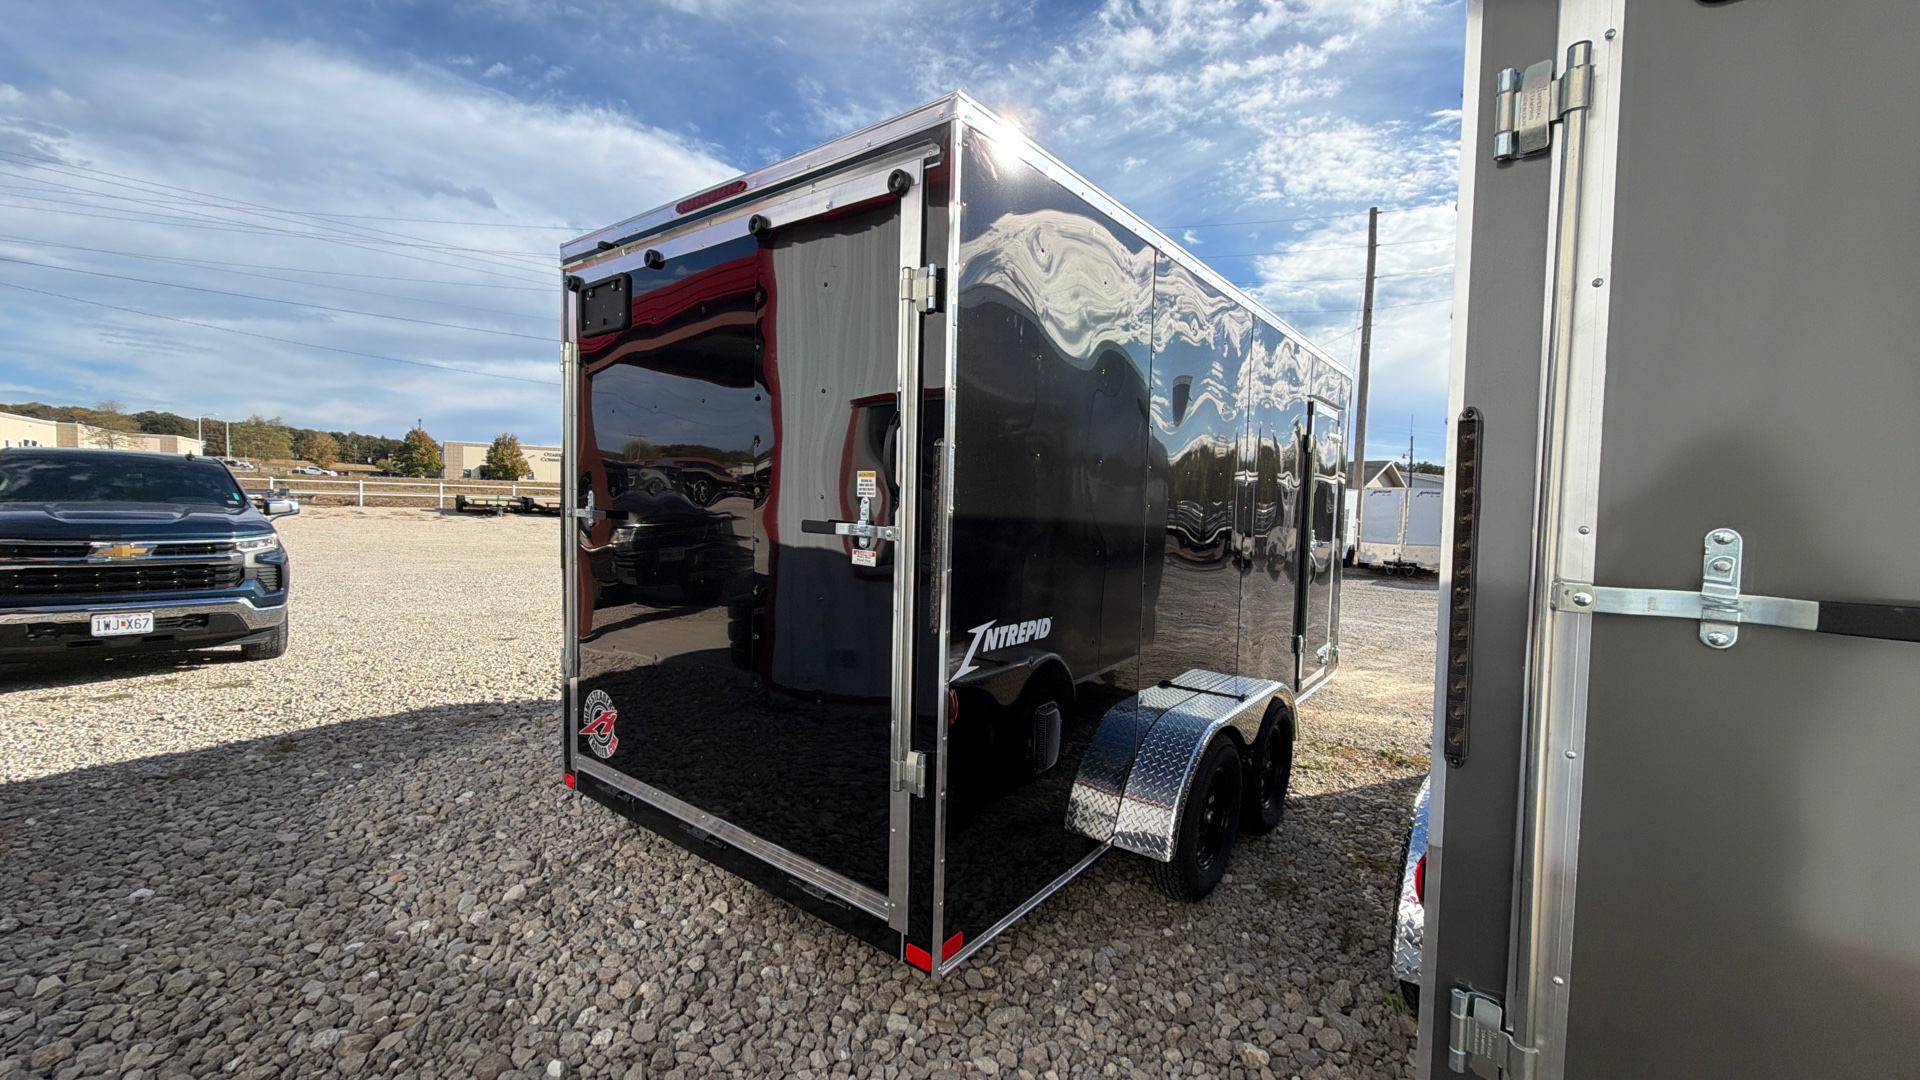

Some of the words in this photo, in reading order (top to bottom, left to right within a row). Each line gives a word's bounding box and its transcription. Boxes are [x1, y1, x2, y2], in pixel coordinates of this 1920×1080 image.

[95, 620, 120, 632] 1WJ
[126, 618, 150, 630] X67
[949, 617, 1052, 682] INTREPID
